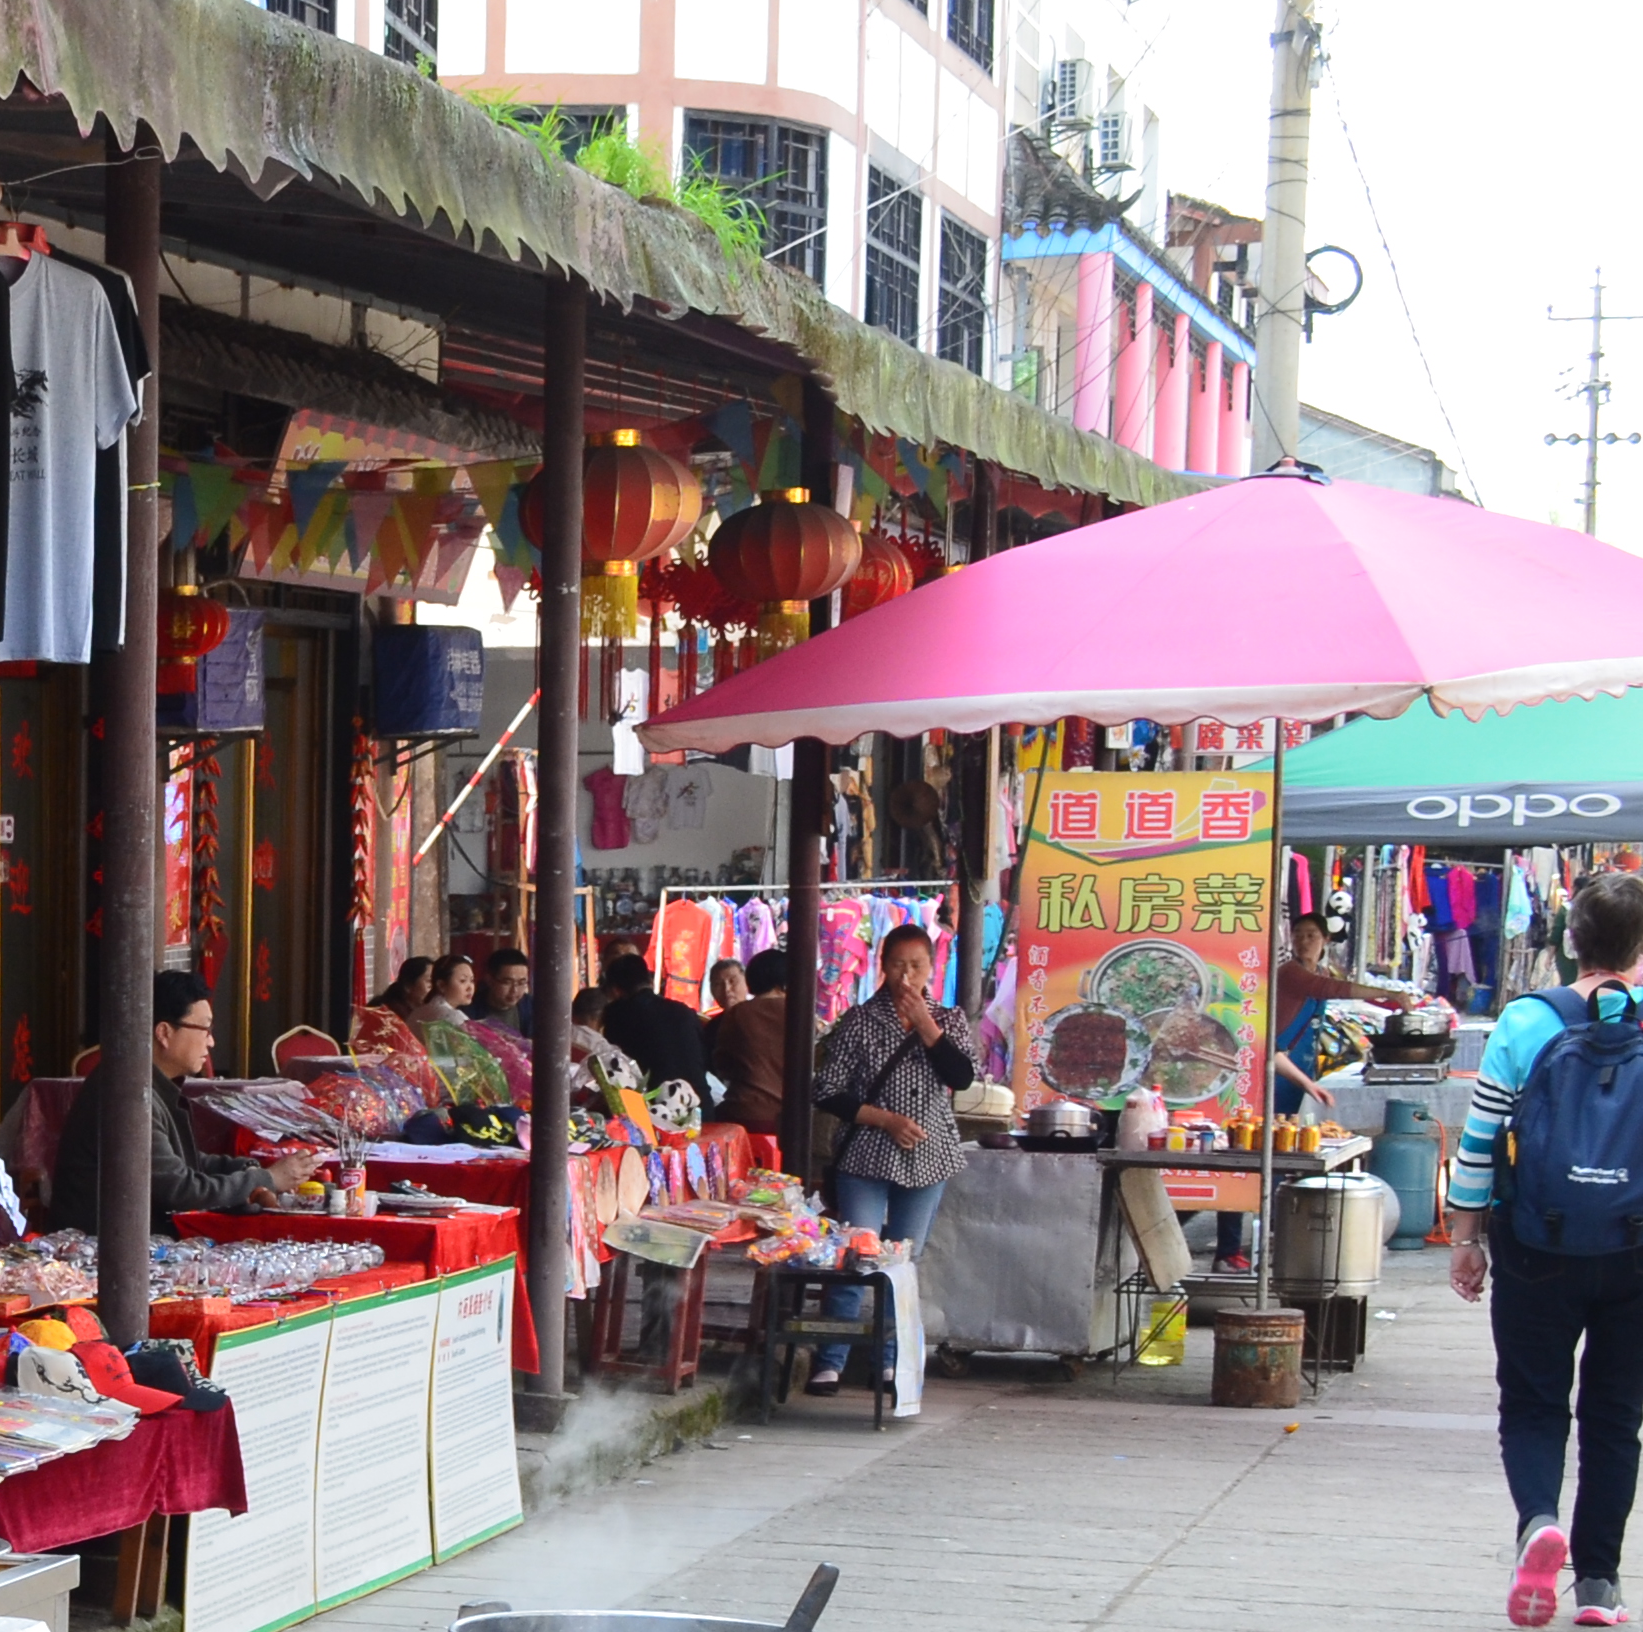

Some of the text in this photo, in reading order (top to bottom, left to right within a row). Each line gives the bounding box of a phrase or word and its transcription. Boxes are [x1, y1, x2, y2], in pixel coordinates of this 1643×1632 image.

[1046, 790, 1253, 842] 道道香
[1037, 873, 1265, 934] 私房菜
